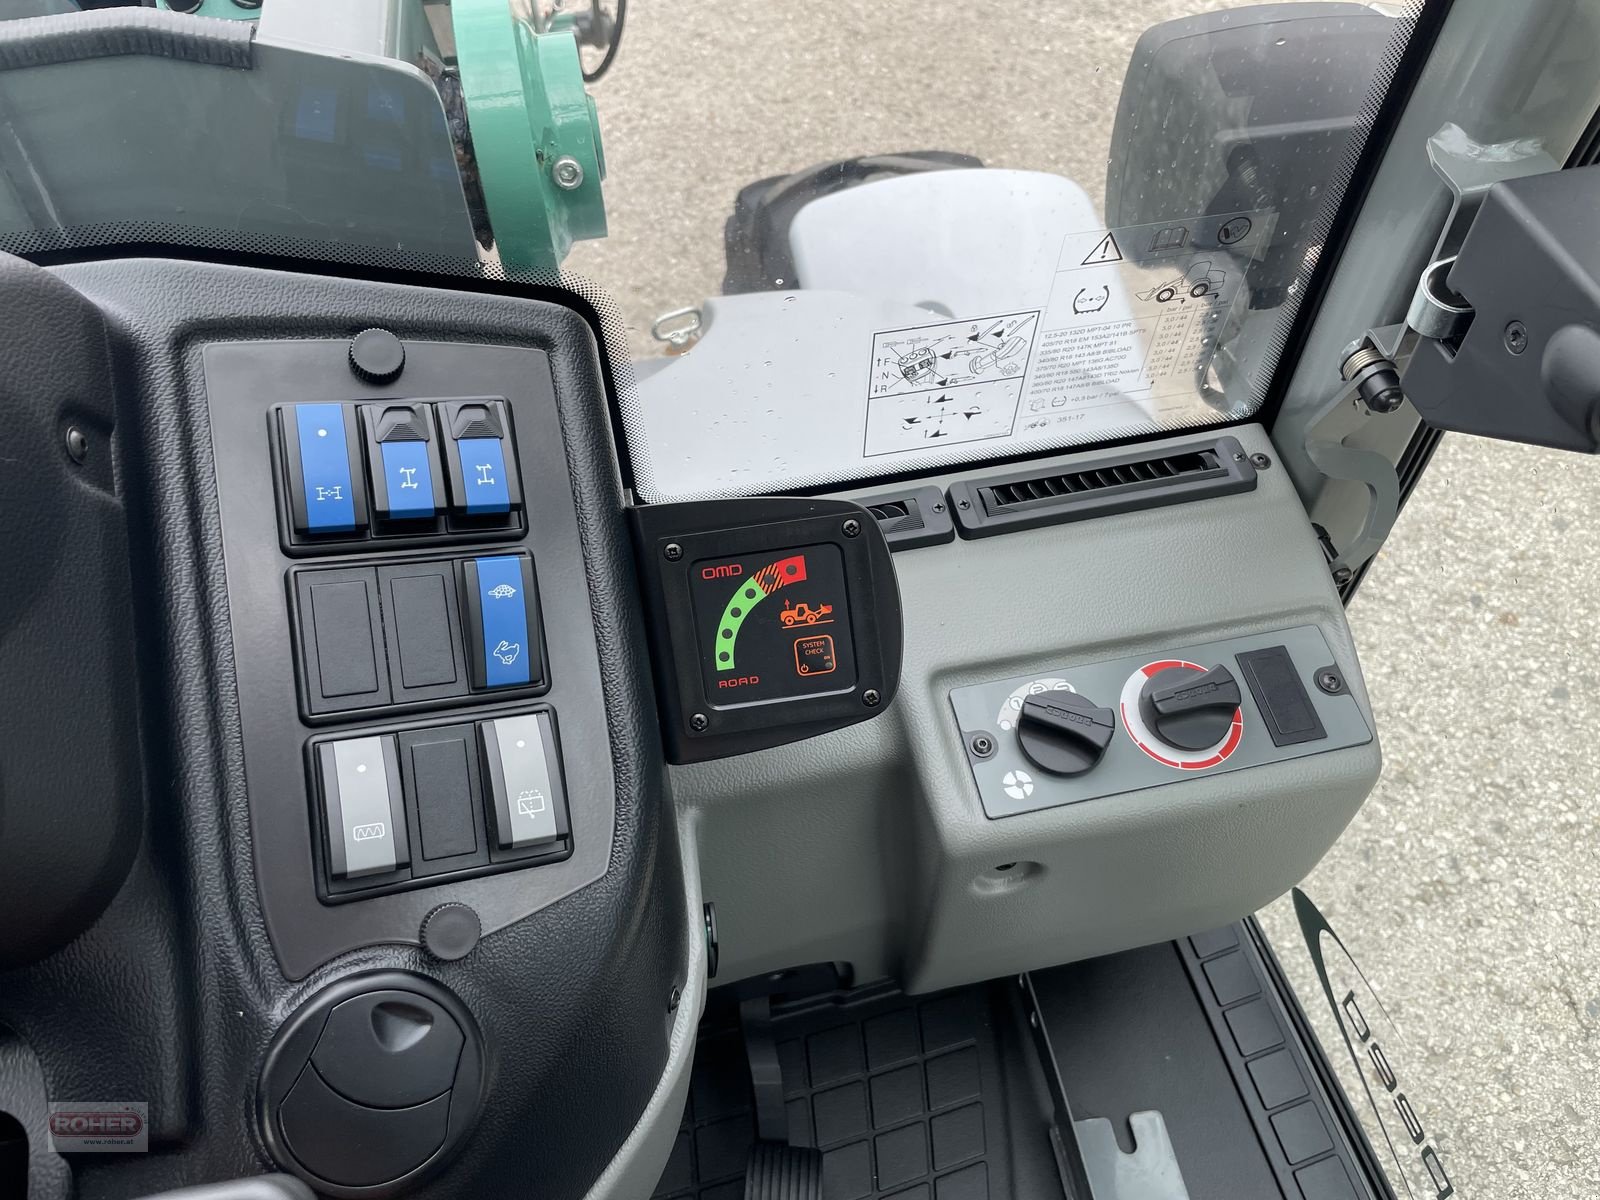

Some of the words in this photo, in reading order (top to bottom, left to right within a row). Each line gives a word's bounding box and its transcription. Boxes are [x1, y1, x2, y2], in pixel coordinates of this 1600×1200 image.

[884, 358, 891, 366] F
[702, 564, 743, 579] OMD
[802, 641, 825, 649] SYSTEM
[718, 676, 759, 688] ROAD
